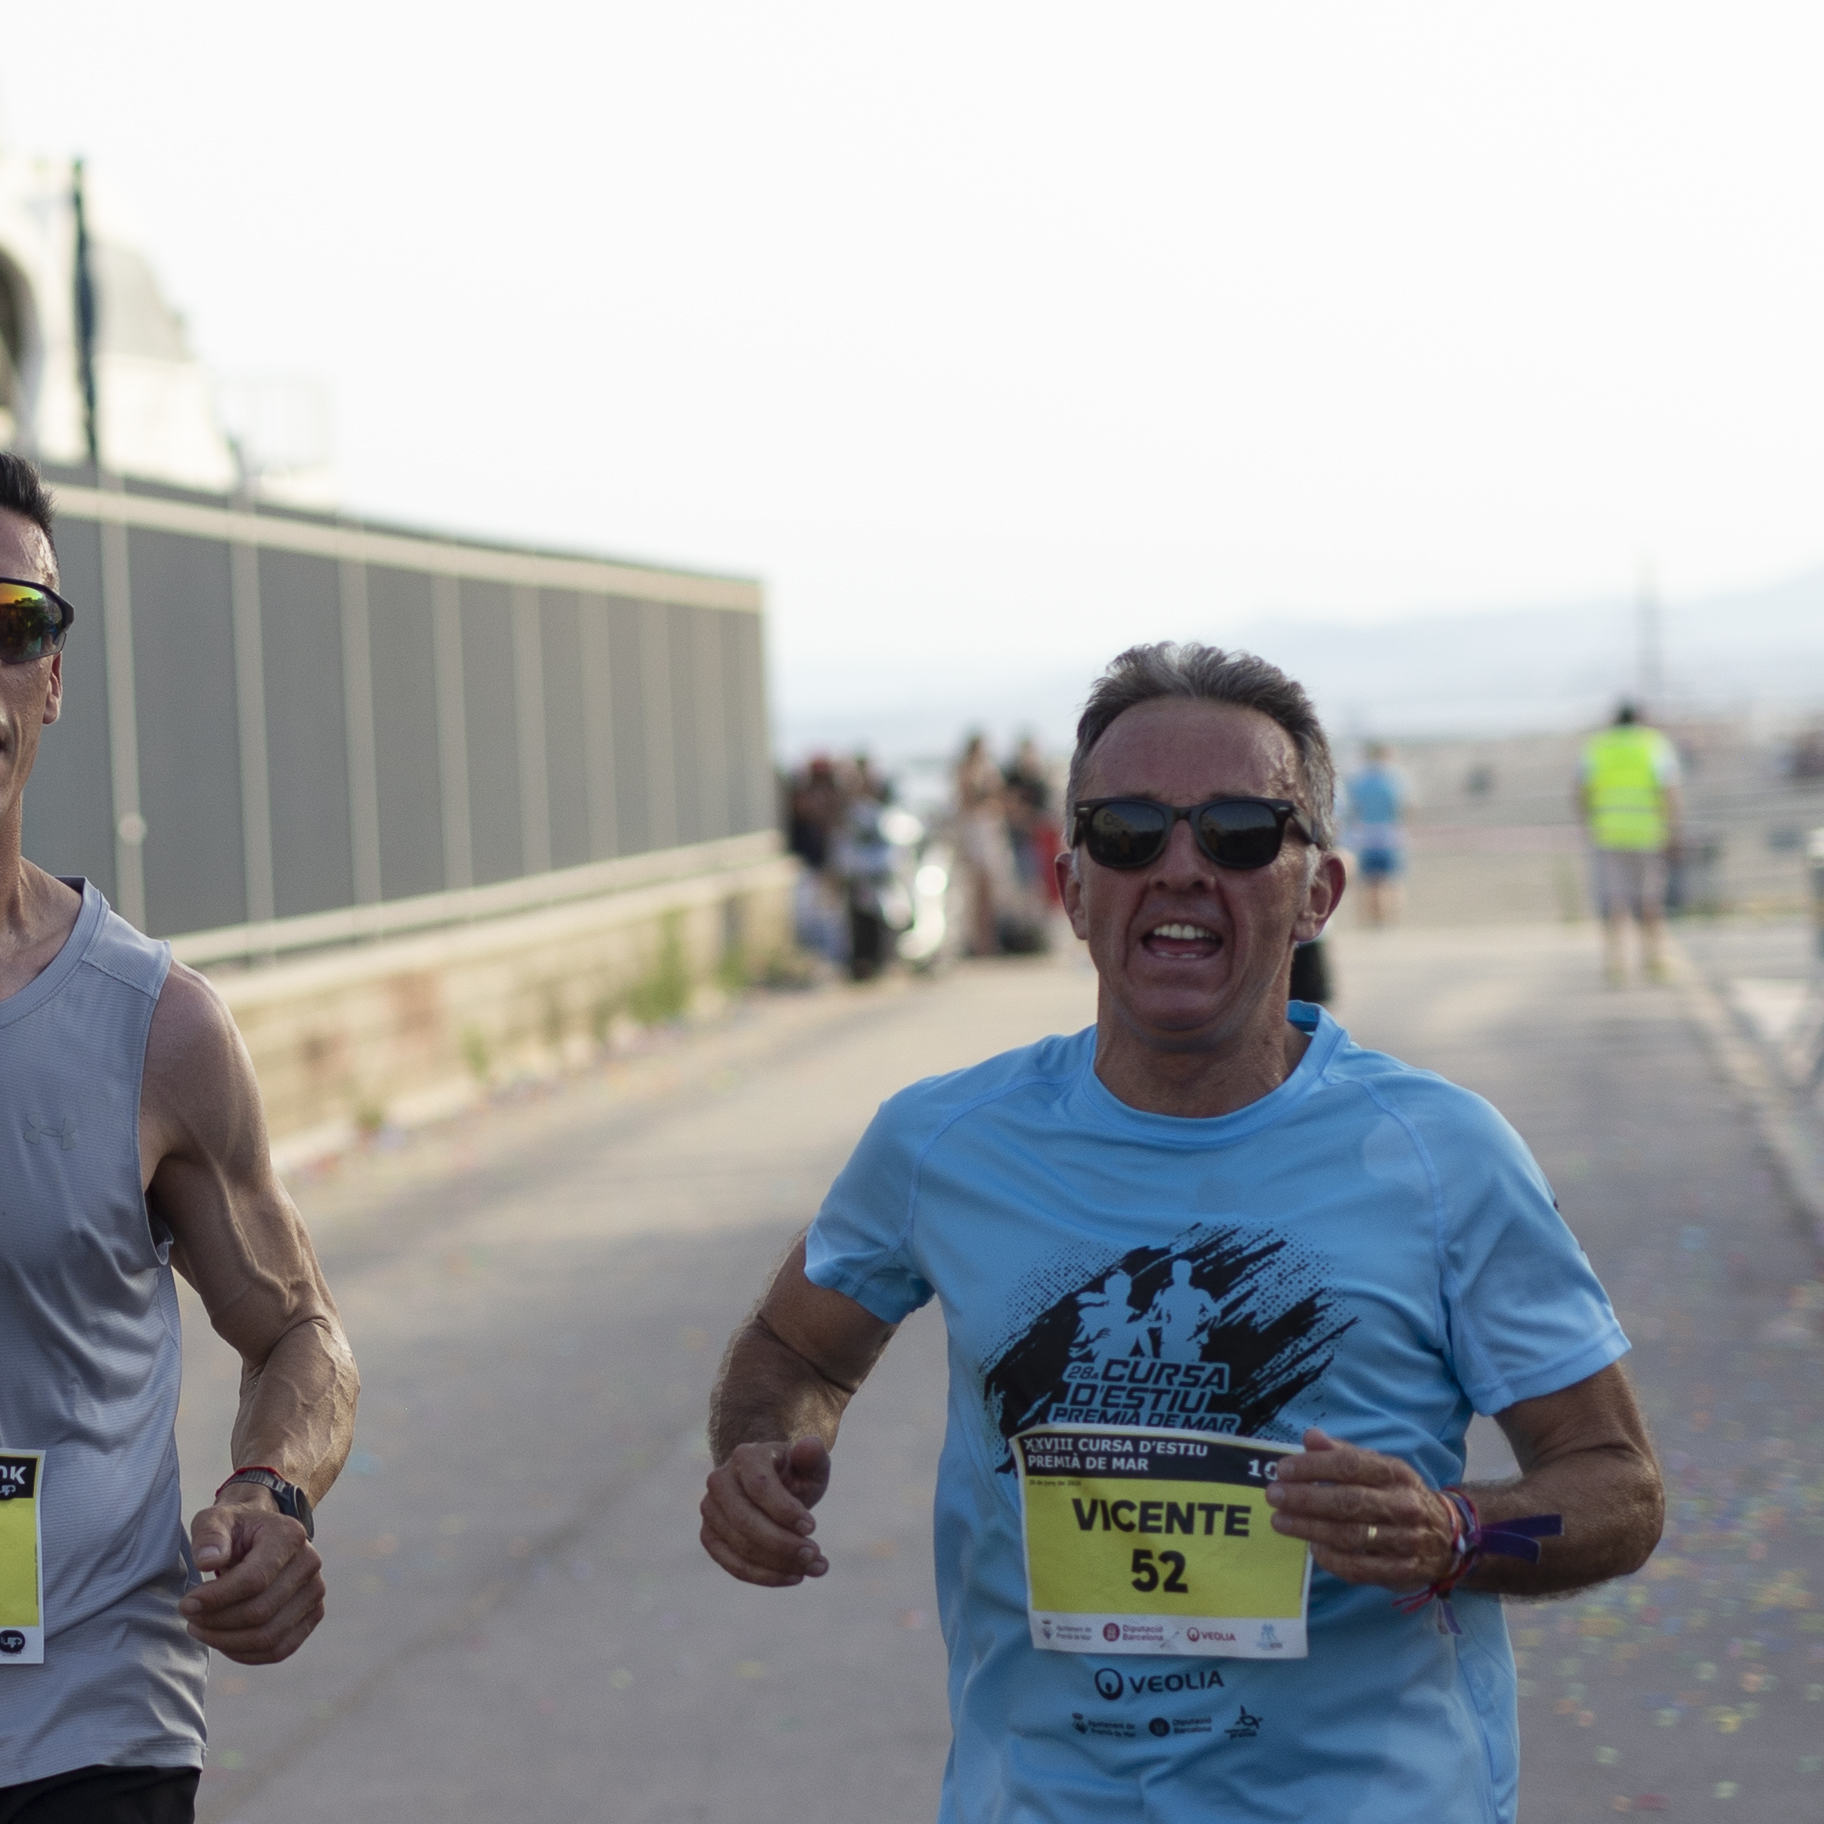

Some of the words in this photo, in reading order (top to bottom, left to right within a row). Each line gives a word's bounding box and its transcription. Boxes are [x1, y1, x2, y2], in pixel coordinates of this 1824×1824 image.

[1101, 1359, 1226, 1390] CURSA
[1070, 1383, 1206, 1413] D'ESTIU
[1146, 1412, 1177, 1428] DE
[1181, 1415, 1237, 1435] MAR
[1078, 1438, 1133, 1453] CURSA
[1139, 1441, 1208, 1456] D'ESTIU
[1028, 1453, 1081, 1469] PREMIÀ
[1086, 1458, 1106, 1469] DE
[1112, 1458, 1149, 1471] MAR
[1248, 1459, 1280, 1480] 10
[1072, 1498, 1251, 1537] VICENTE
[1130, 1549, 1189, 1594] 52
[1129, 1670, 1224, 1694] VEOLIA
